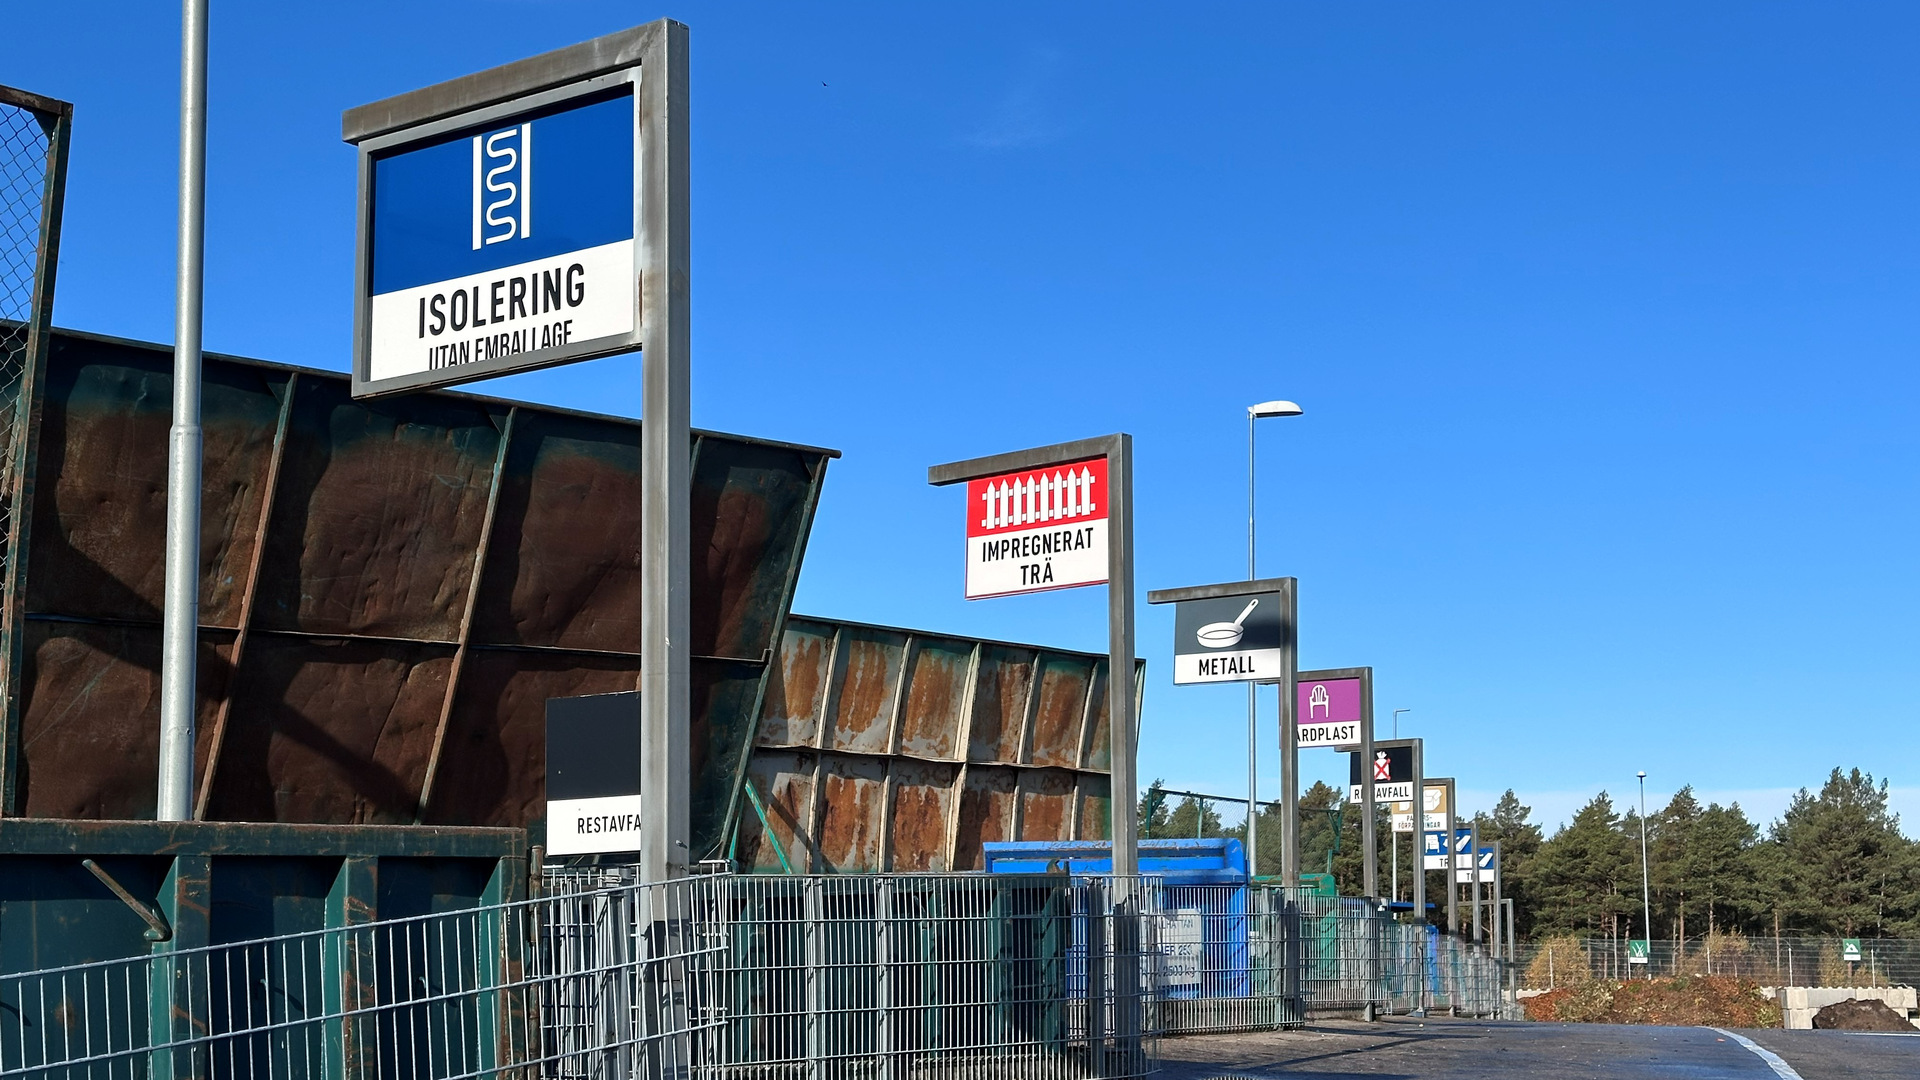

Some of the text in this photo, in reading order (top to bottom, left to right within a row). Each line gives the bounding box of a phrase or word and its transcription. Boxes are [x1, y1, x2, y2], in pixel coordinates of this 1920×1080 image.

[418, 263, 585, 338] ISOLERING
[429, 340, 470, 370] UTAN
[982, 527, 1094, 562] IMPREGNERAT
[1020, 557, 1054, 585] TRÄ
[1198, 655, 1256, 676] METALL
[1297, 725, 1355, 742] ARDPLAST
[1354, 786, 1410, 800] RAVFALL
[577, 814, 642, 834] RESTAVFA
